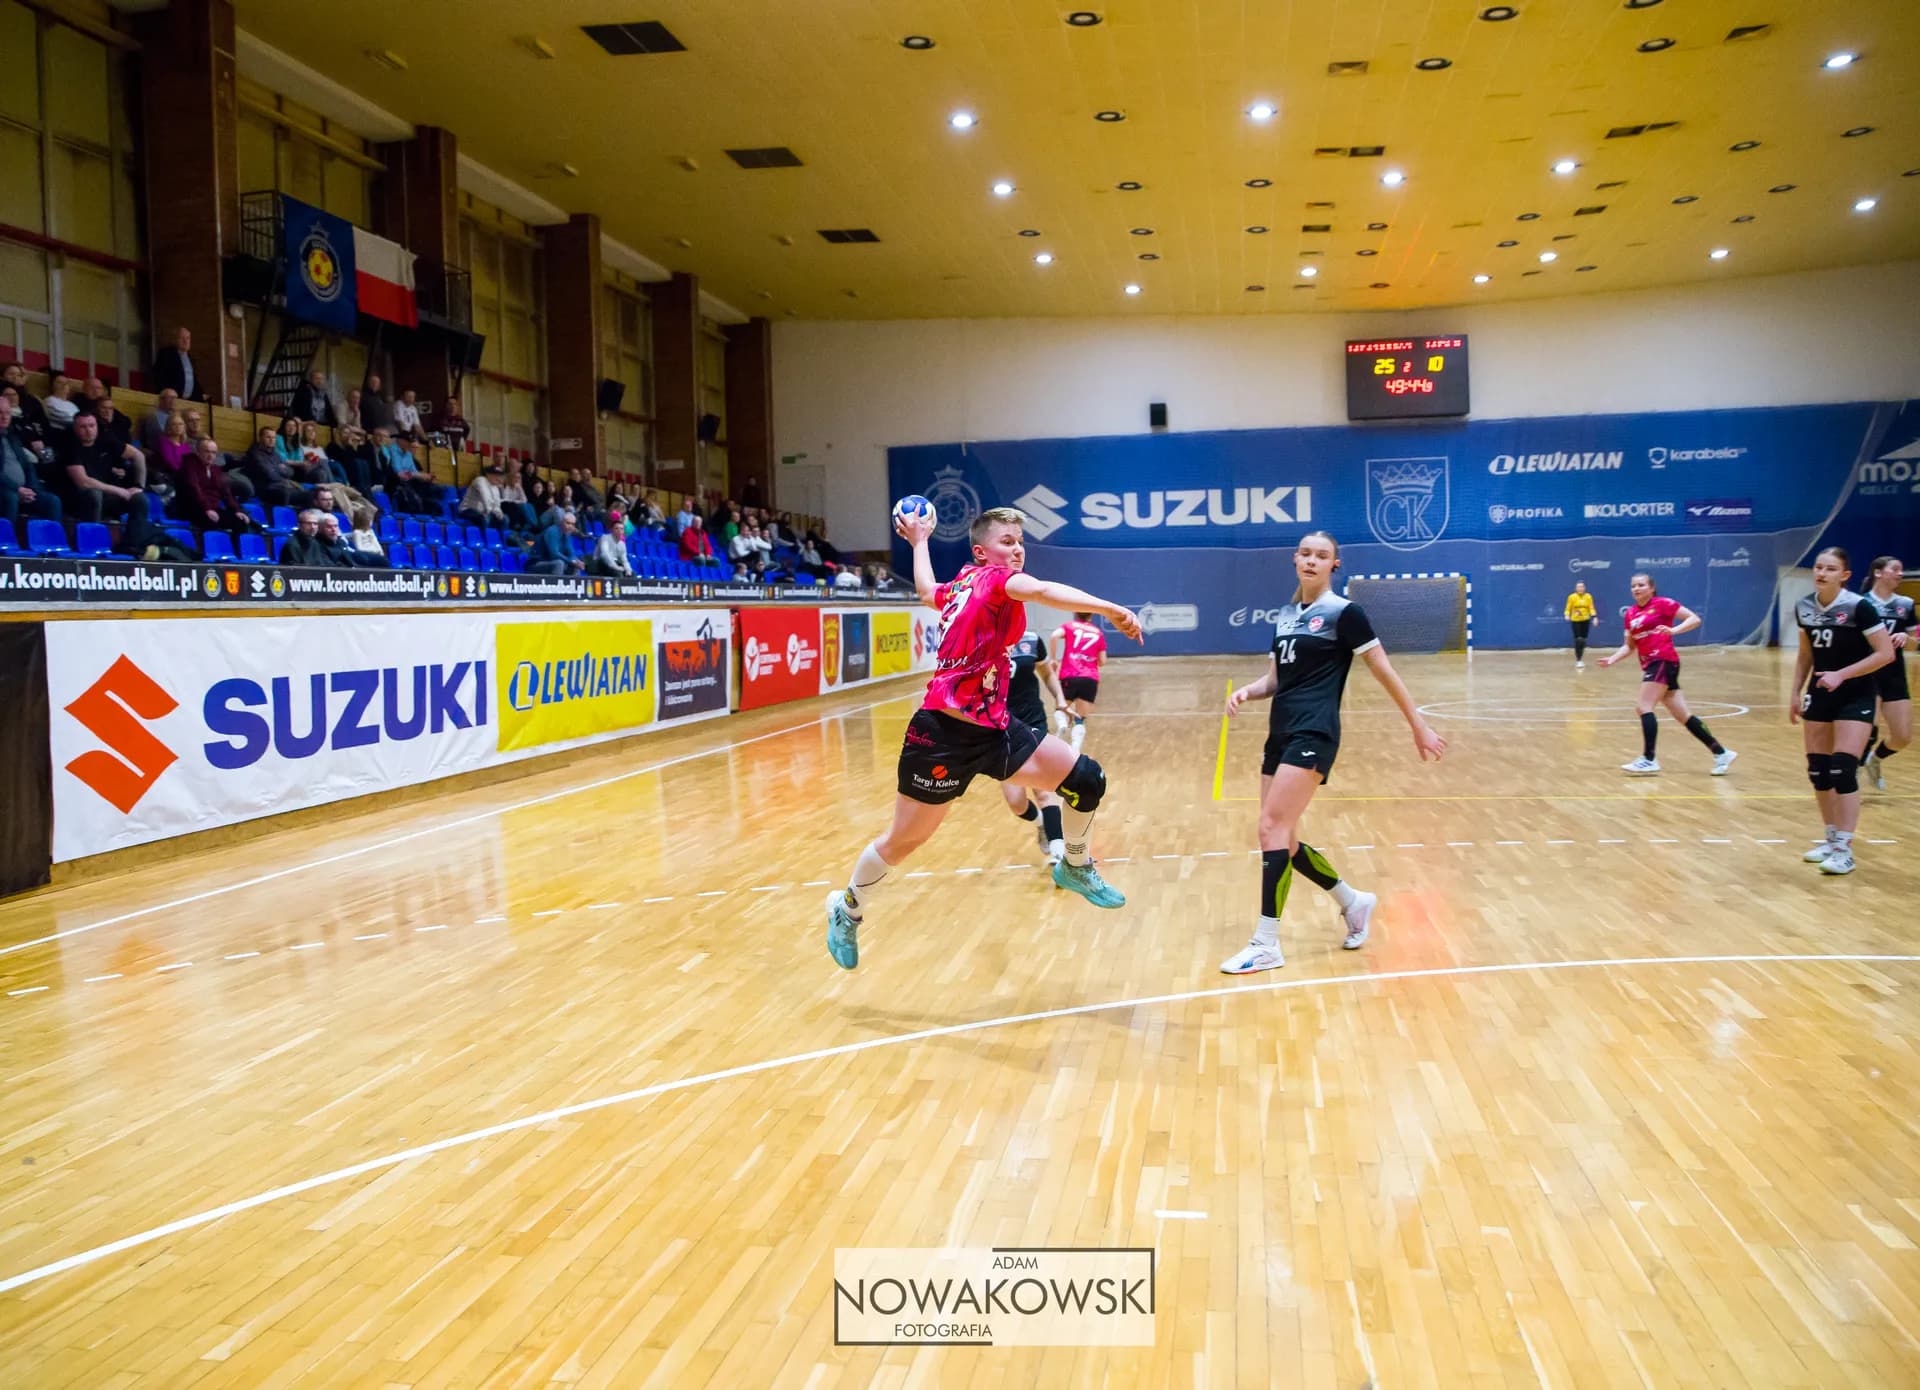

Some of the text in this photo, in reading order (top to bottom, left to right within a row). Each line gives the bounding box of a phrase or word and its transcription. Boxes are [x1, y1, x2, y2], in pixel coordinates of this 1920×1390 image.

[1374, 358, 1395, 374] 25
[1428, 356, 1444, 371] 10
[1515, 452, 1624, 473] LEWIATAN
[1080, 486, 1312, 531] SUZUKI
[1508, 507, 1564, 518] PROFIKA
[1592, 502, 1675, 517] KOLPORTER
[289, 573, 434, 598] www.koronahandball.pl
[1073, 629, 1099, 650] 17
[1811, 629, 1833, 648] 29
[541, 651, 648, 704] LEWIATAN
[203, 660, 488, 770] SUZUKI
[912, 773, 933, 787] Targi
